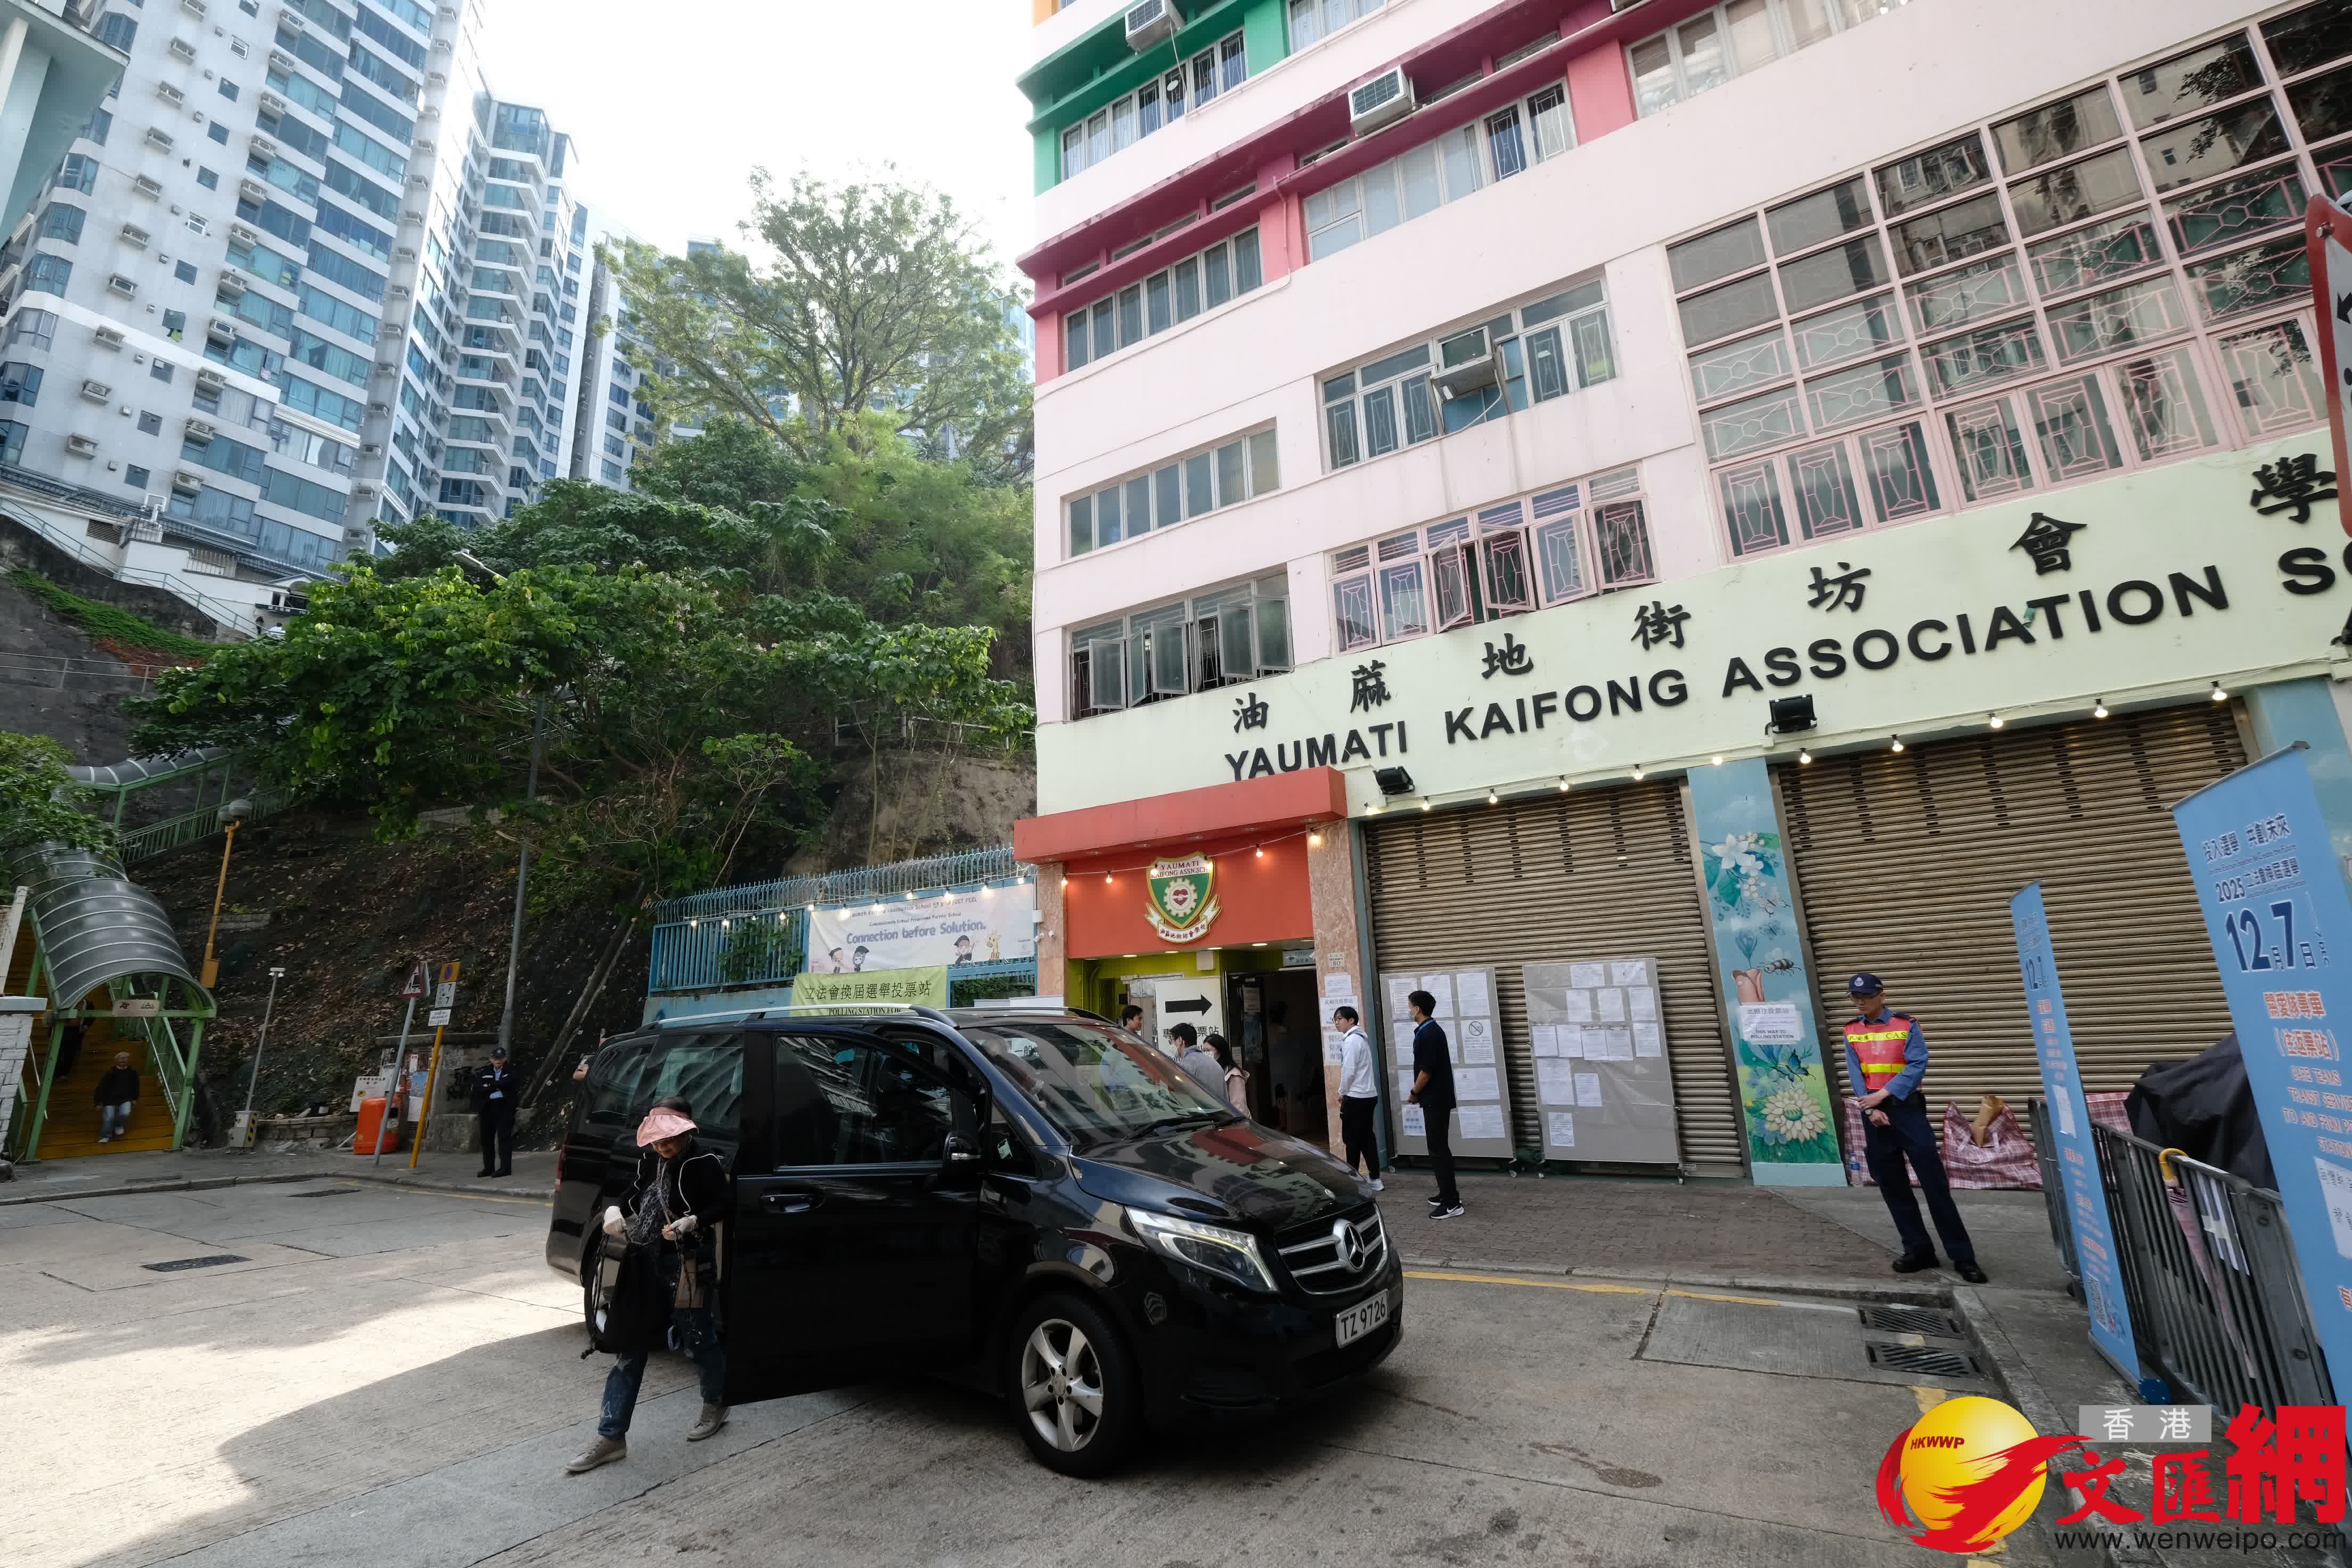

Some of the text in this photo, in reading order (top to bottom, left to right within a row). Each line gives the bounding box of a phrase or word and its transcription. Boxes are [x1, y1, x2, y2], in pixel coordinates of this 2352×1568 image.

[1225, 540, 2352, 781] YAUMATI KAIFONG ASSOCIATION S
[1161, 860, 1199, 870] YAUMATI
[846, 919, 987, 945] Connection before Solution.
[805, 980, 932, 1001] 立法會換屆選舉投票站
[1163, 1025, 1219, 1039] 專票站
[1341, 1296, 1385, 1340] TZ 9726
